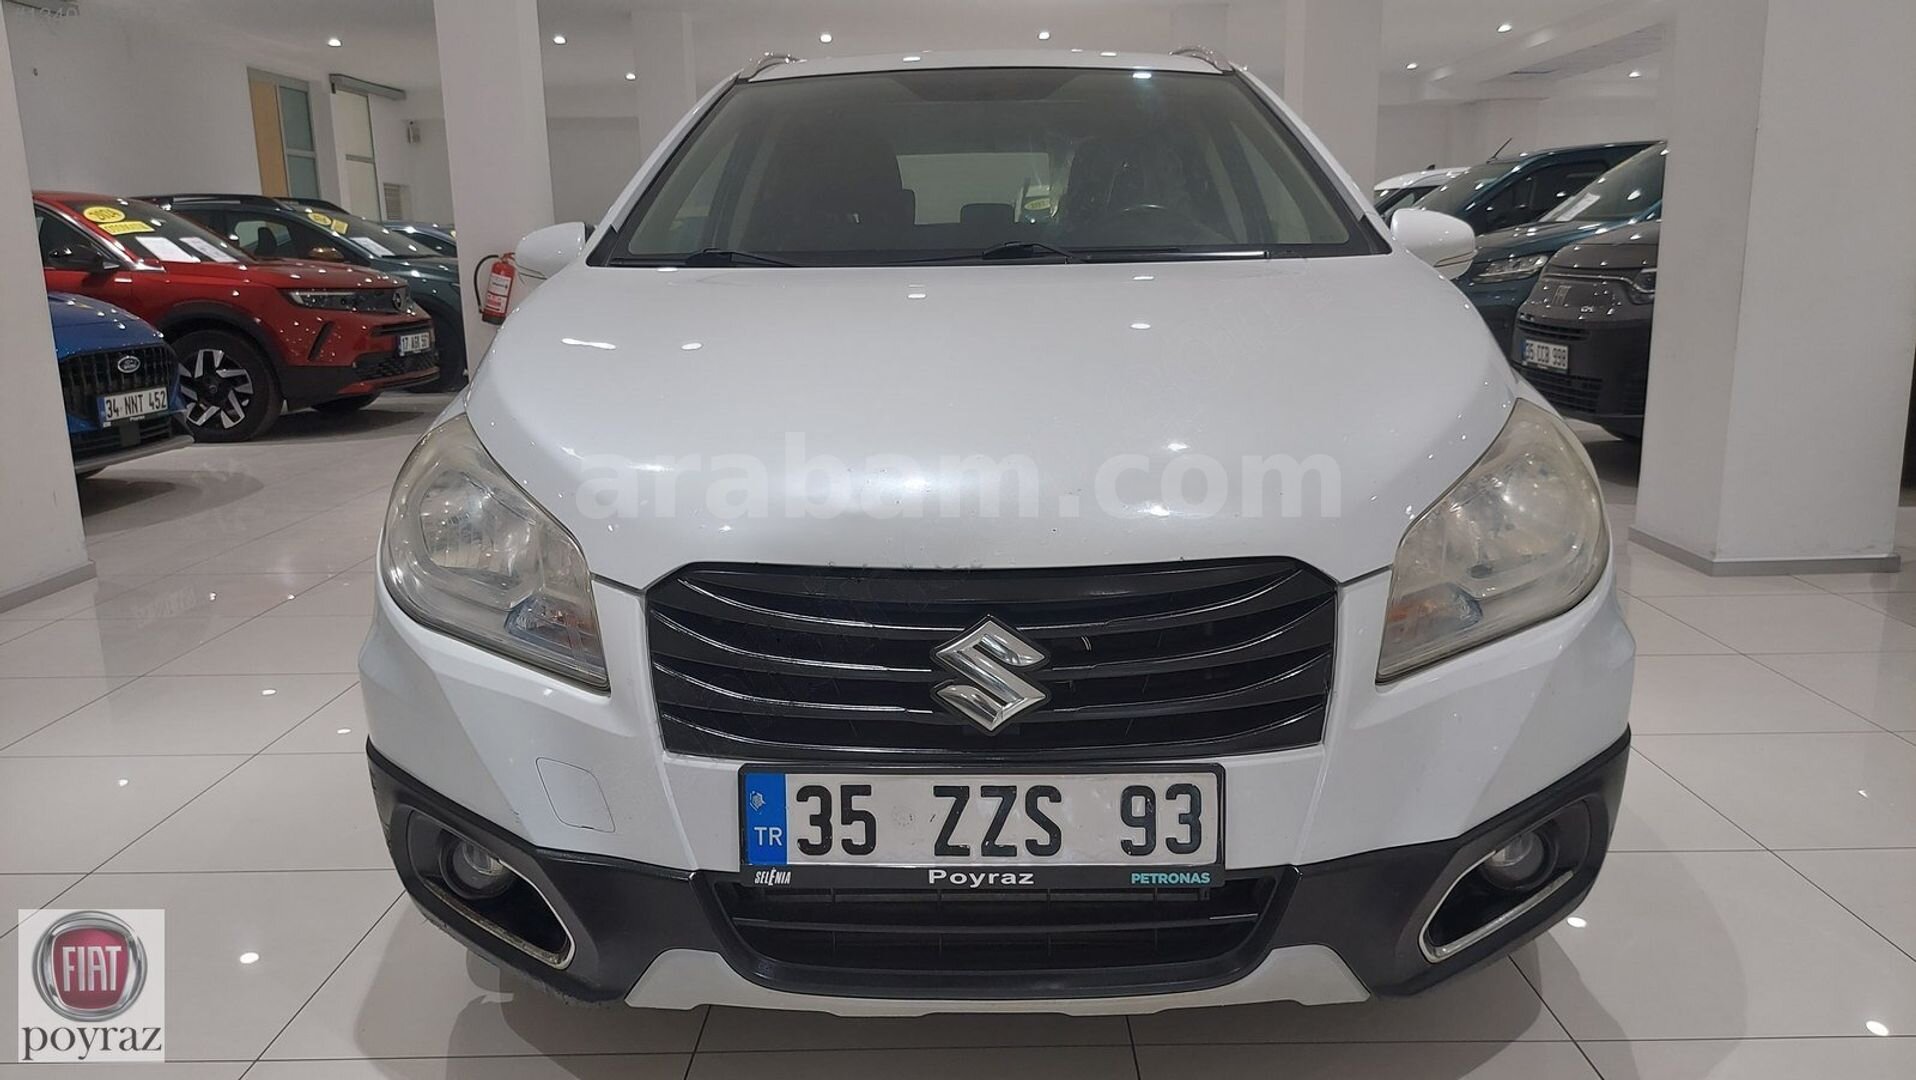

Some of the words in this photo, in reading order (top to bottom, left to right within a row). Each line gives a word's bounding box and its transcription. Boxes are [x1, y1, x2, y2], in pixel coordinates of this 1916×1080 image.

[105, 399, 120, 418] 34
[124, 394, 144, 415] NNT
[148, 390, 167, 410] 452
[796, 784, 877, 856] 35
[933, 785, 1062, 857] ZZS
[1120, 783, 1202, 857] 93
[753, 826, 783, 847] TR
[928, 869, 1035, 889] Poyraz
[1131, 872, 1211, 885] PETRONAS
